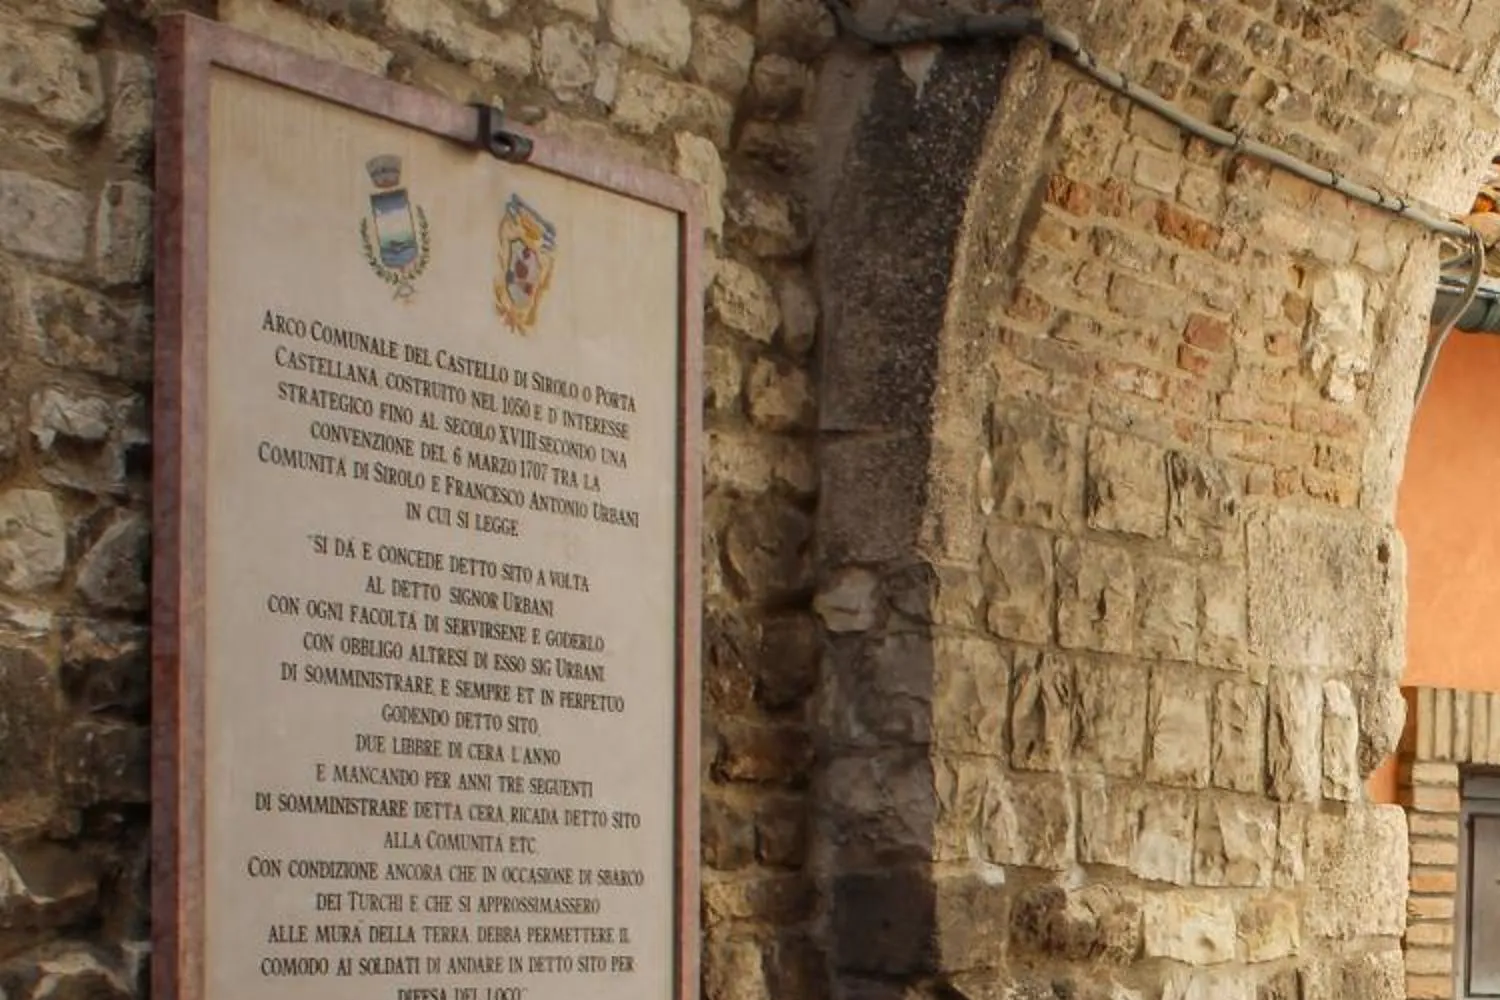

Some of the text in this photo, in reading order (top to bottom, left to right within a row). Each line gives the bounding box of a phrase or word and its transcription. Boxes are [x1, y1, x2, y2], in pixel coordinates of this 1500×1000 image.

[262, 309, 636, 412] ARCO COMUNALE DEL CASTELLO DI SIROLO O PORTA
[275, 345, 378, 387] CASTELLANA
[385, 372, 466, 404] COSTRUITO
[471, 391, 497, 412] NEL
[534, 404, 542, 421] E
[278, 381, 373, 417] STRATEGICO
[380, 402, 413, 425] FINO
[420, 412, 438, 430] AL
[444, 416, 496, 441] SECOLO
[499, 425, 536, 450] XVIII
[539, 435, 596, 461] SECONDO
[310, 421, 601, 493] CONVENZIONE DEL 6 MARZO 1707 TRA LA
[353, 461, 368, 481] DI
[373, 461, 425, 490] SIROLO
[431, 476, 441, 493] E
[445, 475, 525, 508] FRANCESCO
[529, 491, 589, 519] ANTONIO
[593, 502, 640, 529] URBANI
[406, 502, 421, 520] IN
[427, 505, 451, 527] CUI
[457, 511, 469, 529] SI
[362, 541, 373, 561] E
[378, 545, 444, 571] CONCEDE
[450, 554, 497, 579] DETTO
[501, 564, 532, 585] SITO
[536, 569, 545, 587] A
[550, 570, 590, 593] VOLTA
[365, 575, 553, 618] AL DETTO SIGNOR URBANI
[267, 594, 299, 615] CON
[306, 599, 344, 622] OGNI
[425, 613, 439, 633] DI
[445, 616, 526, 643] SERVIRSENE
[532, 627, 540, 645] E
[546, 629, 604, 652] GODERLO
[303, 632, 335, 652] CON
[340, 637, 403, 661] OBBLIGO
[474, 651, 488, 670] DI
[494, 654, 526, 673] ESSO
[555, 658, 605, 682] URBANI
[280, 662, 297, 681] DI
[441, 679, 449, 696] E
[455, 679, 511, 702] SEMPRE
[517, 686, 535, 704] ET
[541, 689, 554, 707] IN
[560, 691, 625, 712] PERPETUO
[382, 704, 449, 727] GODENDO
[455, 711, 502, 731] DETTO
[355, 733, 386, 754] DUE
[392, 736, 442, 758] LIBBRE
[448, 741, 462, 759] DI
[468, 743, 504, 763] CERA
[316, 763, 593, 798] E MANCANDO PER ANNI TRE SEGUENTI
[255, 791, 271, 812] DI
[278, 793, 408, 818] SOMMINISTRARE
[414, 801, 463, 821] DETTA
[511, 807, 559, 826] RICADA
[565, 809, 607, 828] DETTO
[611, 811, 641, 829] SITO
[384, 831, 421, 849] ALLA
[248, 855, 644, 887] CON CONDIZIONE ANCORA CHE IN OCCASIONE DI SBARCO
[316, 890, 600, 915] DEI TURCHI E CHE SI APPROSSIMASSERO
[268, 925, 308, 943] ALLE
[315, 925, 362, 943] MURA
[369, 925, 416, 943] DELLA
[477, 925, 521, 943] DEBBA
[527, 926, 614, 944] PERMETTERE
[619, 927, 631, 944] IL
[261, 955, 635, 977] COMODO AI SOLDATI DI ANDARE IN DETTO SITO PER
